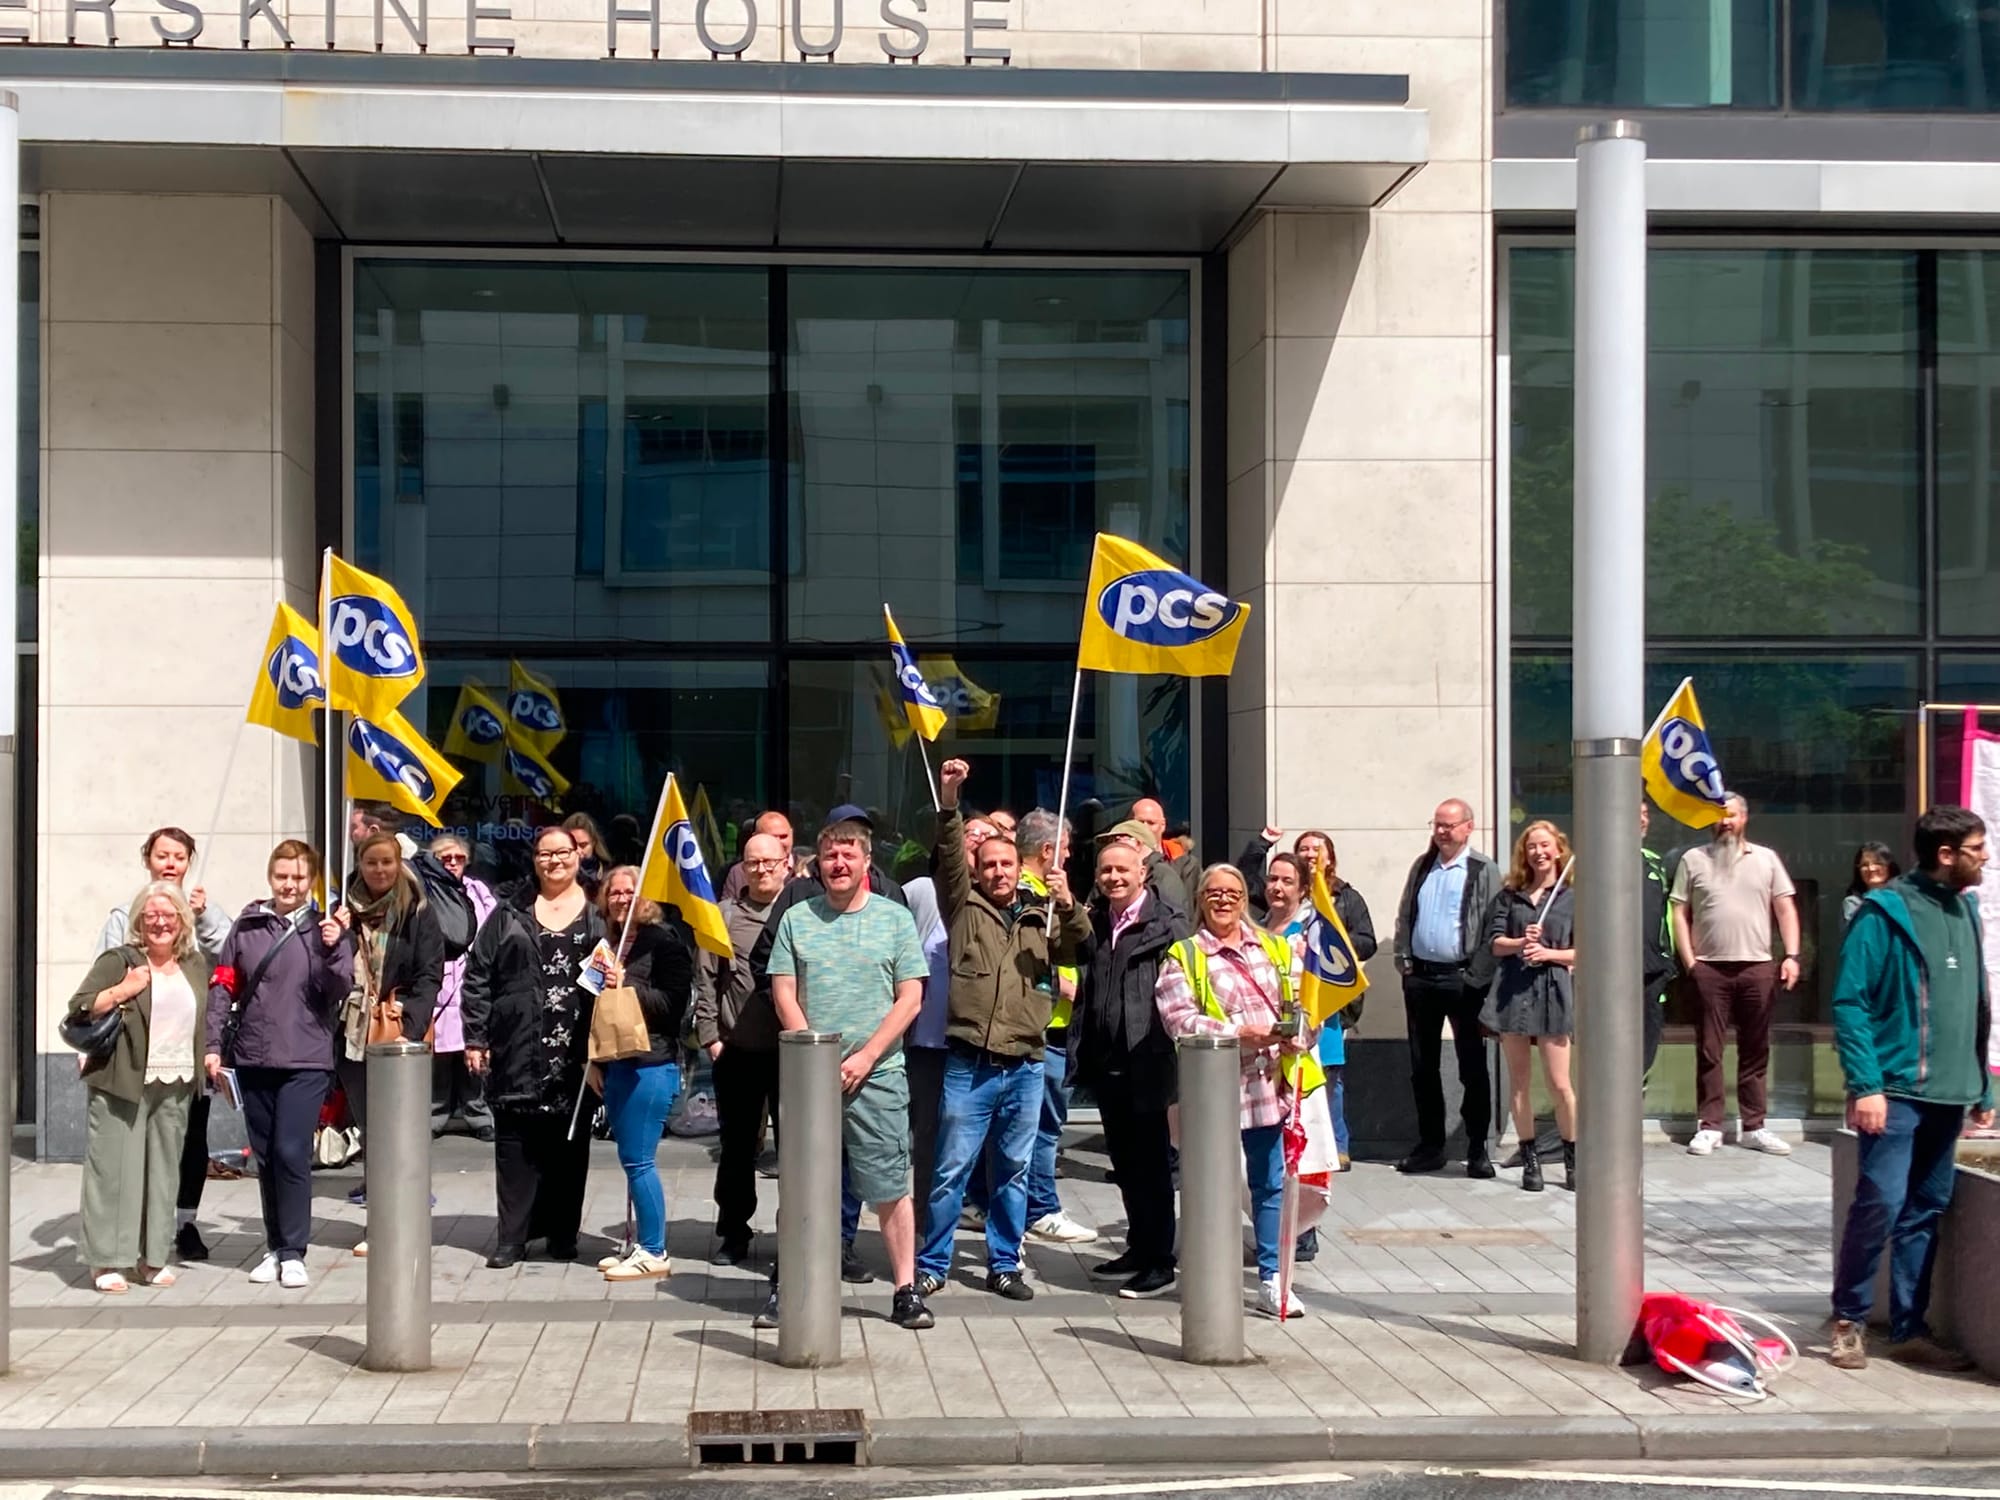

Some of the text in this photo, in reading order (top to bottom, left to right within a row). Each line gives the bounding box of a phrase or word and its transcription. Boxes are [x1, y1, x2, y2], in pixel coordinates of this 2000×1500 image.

[607, 0, 1012, 58] HOUSE
[330, 601, 412, 670] pcs
[1114, 583, 1230, 637] pcs
